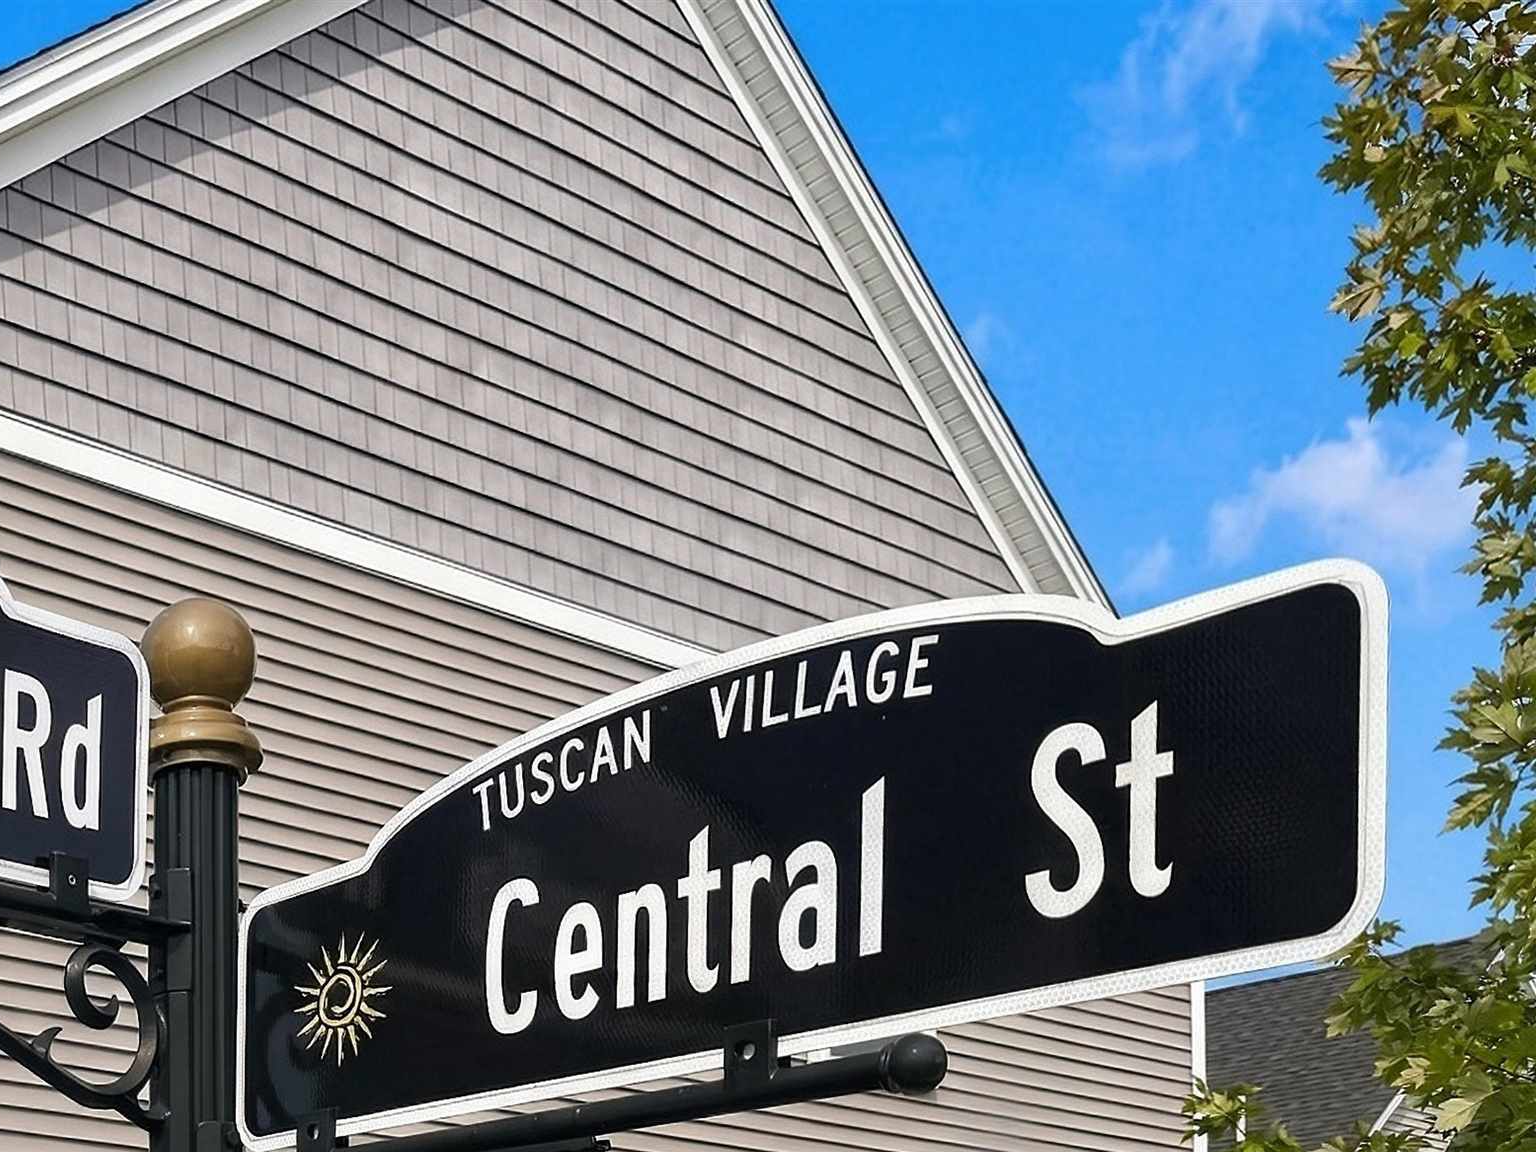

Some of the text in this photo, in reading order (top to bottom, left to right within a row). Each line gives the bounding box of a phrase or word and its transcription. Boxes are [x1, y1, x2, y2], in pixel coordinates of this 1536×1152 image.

[1, 668, 102, 831] Rd
[472, 634, 939, 831] TUSCAN VILLAGE
[485, 700, 1174, 1035] Central St
